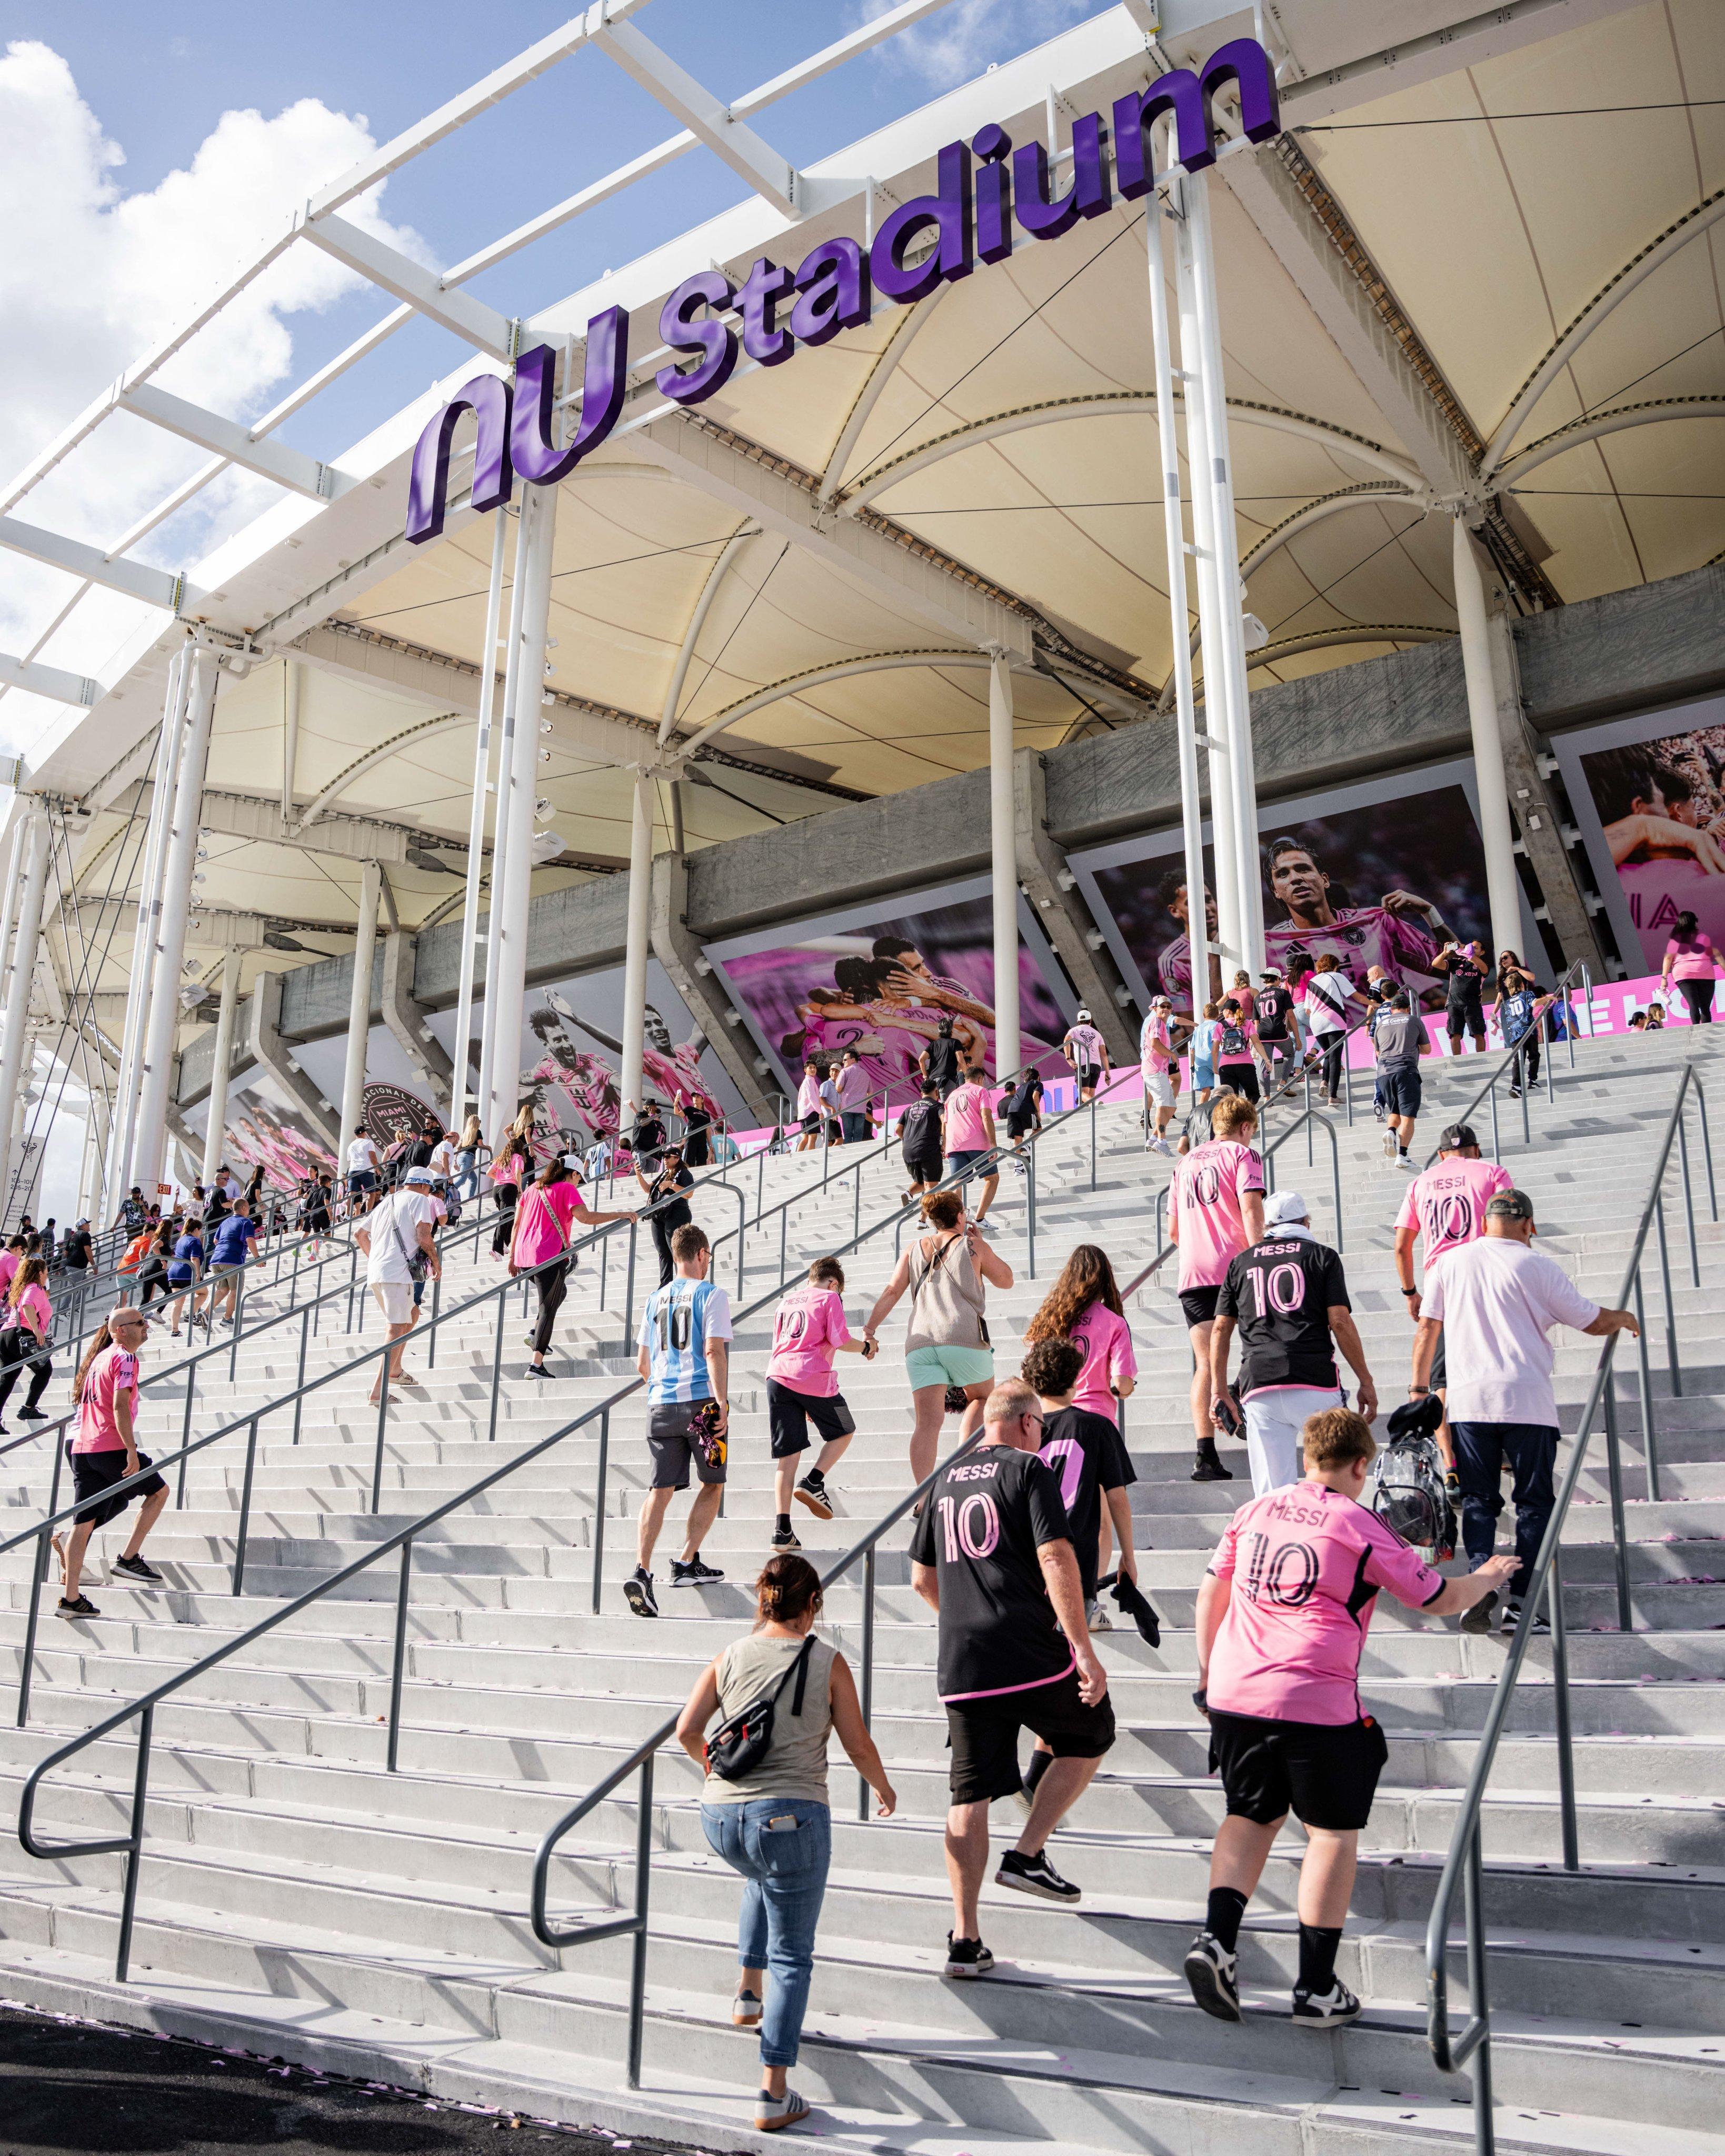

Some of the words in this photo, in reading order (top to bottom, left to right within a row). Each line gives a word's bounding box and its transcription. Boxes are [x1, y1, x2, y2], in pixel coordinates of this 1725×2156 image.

[655, 37, 1280, 405] Stadium
[1260, 991, 1276, 999] MESSI
[1259, 1000, 1277, 1019] 10
[1509, 1000, 1524, 1016] 10
[376, 1106, 406, 1117] MIAMI
[950, 1093, 968, 1114] 10
[371, 1134, 387, 1150] LUB
[411, 1099, 423, 1110] DE
[656, 1131, 665, 1145] 10
[616, 1156, 630, 1168] 10
[1191, 1149, 1221, 1161] MESSI
[159, 1184, 170, 1194] EXIT
[1182, 1165, 1219, 1209] 10
[1427, 1175, 1465, 1191] MESSI
[1423, 1194, 1471, 1244] 10
[1253, 1243, 1301, 1257] MESSI
[1247, 1262, 1305, 1317] 10
[660, 1294, 692, 1305] MESSI
[784, 1296, 809, 1305] MESSI
[653, 1305, 692, 1351] 10
[777, 1310, 805, 1339] 10
[1074, 1316, 1092, 1326] SSI
[947, 1462, 999, 1483] MESSI
[1267, 1502, 1329, 1527] MESSI
[938, 1492, 999, 1563] 10
[1248, 1532, 1319, 1607] 10
